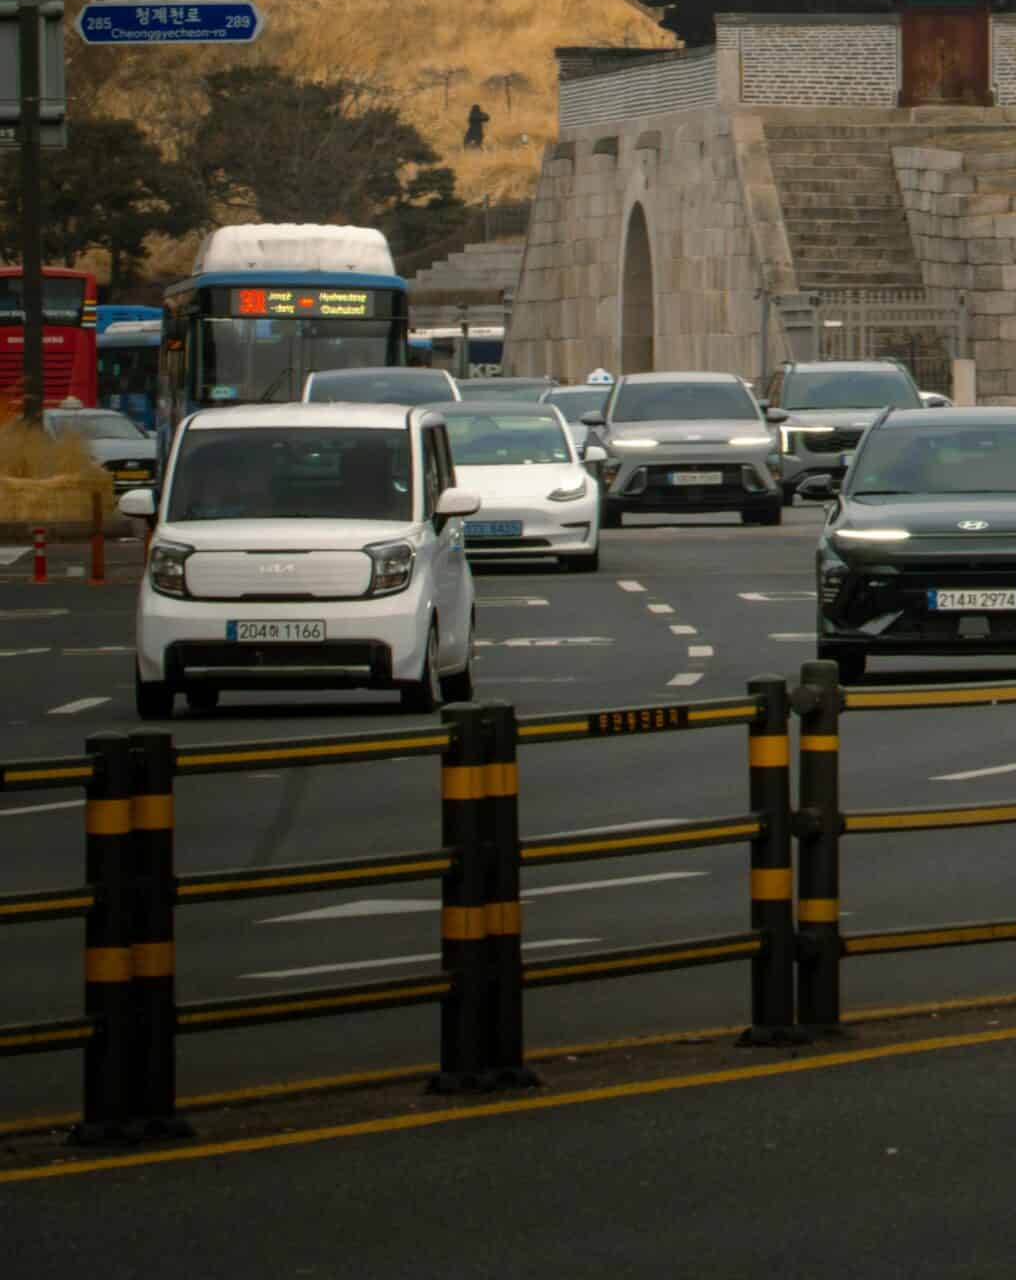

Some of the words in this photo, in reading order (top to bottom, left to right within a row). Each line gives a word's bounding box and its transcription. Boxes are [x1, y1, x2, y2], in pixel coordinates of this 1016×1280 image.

[86, 16, 113, 31] 285
[135, 6, 201, 26] 청계천로
[225, 14, 251, 29] 289
